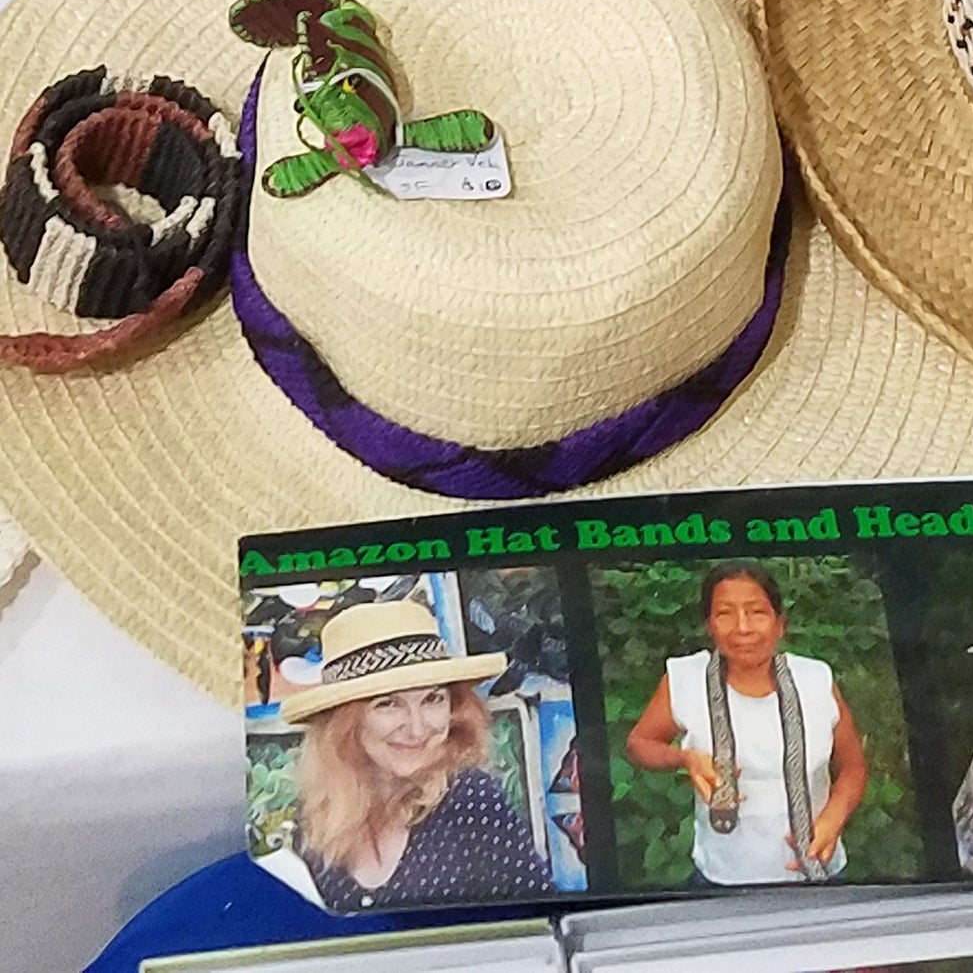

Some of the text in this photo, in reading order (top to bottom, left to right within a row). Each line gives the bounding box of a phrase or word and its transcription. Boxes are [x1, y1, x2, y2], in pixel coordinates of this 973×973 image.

[239, 538, 452, 577] Amazon
[466, 525, 560, 557] Hat
[575, 513, 733, 550] Bands
[746, 507, 841, 543] and
